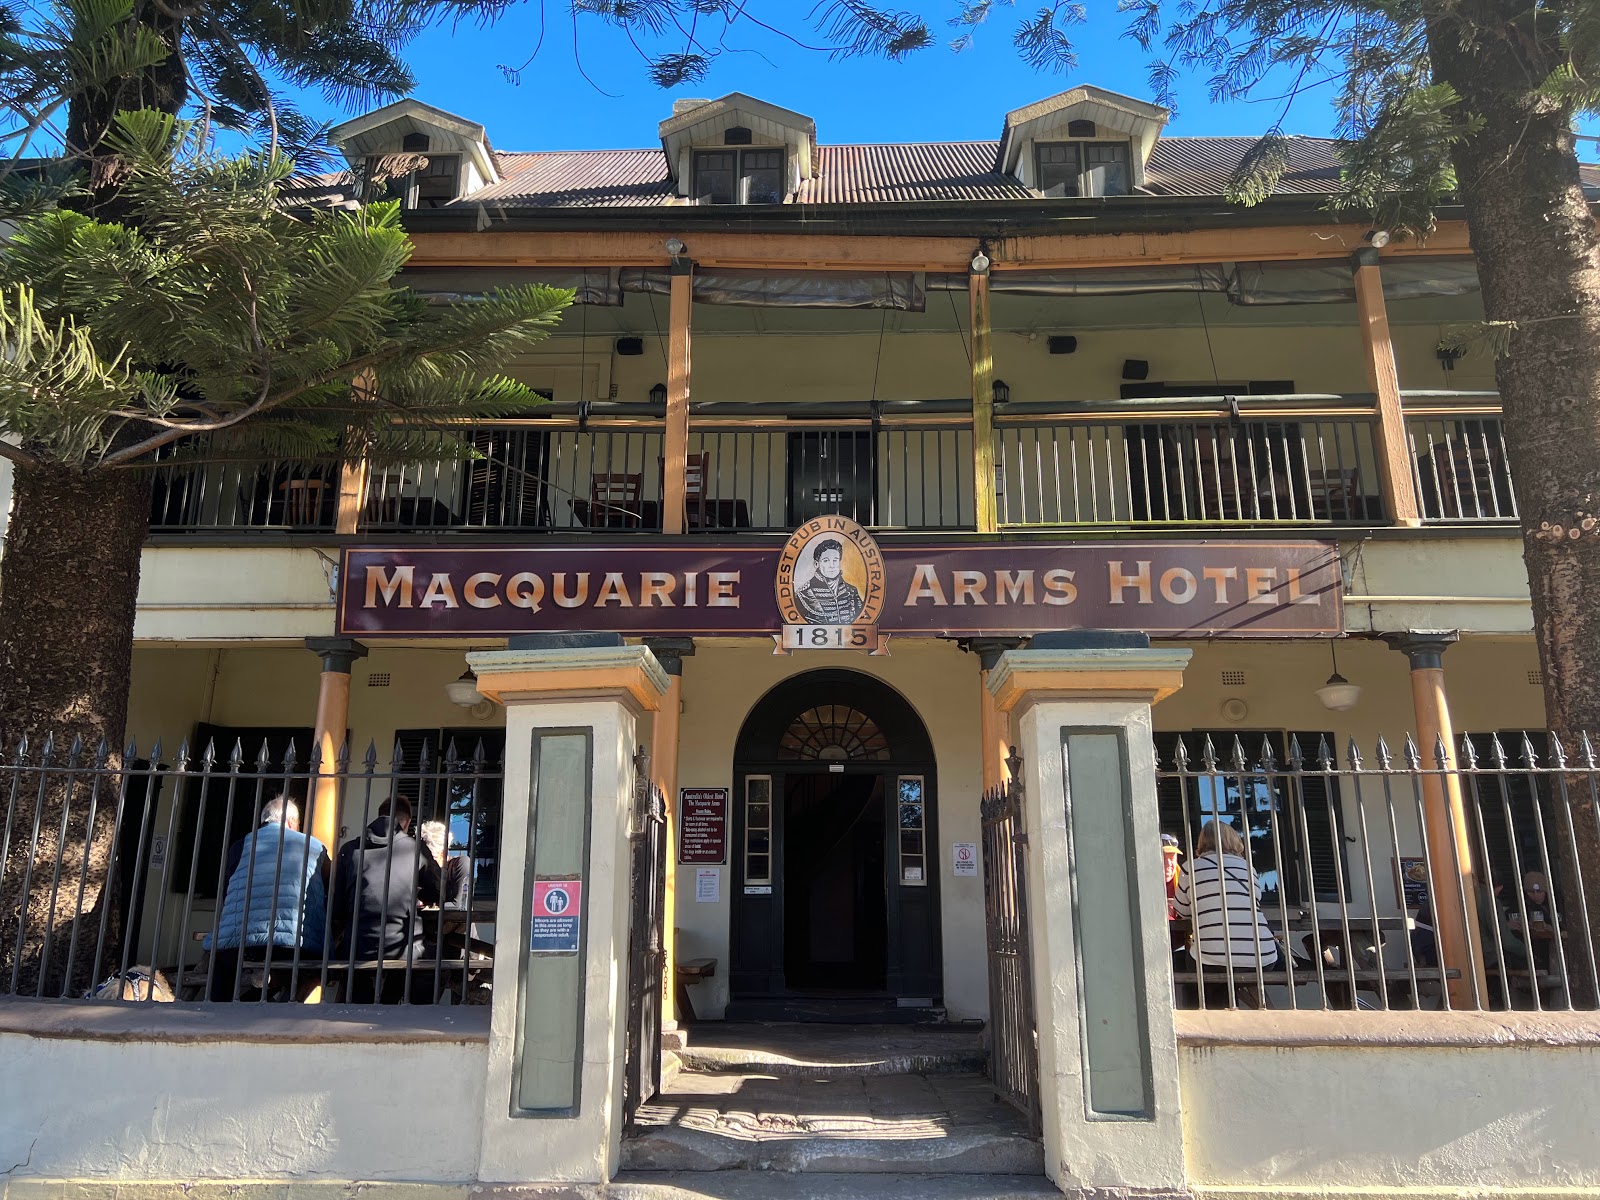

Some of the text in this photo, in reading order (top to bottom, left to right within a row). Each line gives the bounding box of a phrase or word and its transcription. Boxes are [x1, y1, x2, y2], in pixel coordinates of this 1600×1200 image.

[362, 560, 1321, 614] MACQUARIE ARMS HOTEL
[780, 518, 882, 622] OLDEST PUB IN AUSTRALIA
[795, 627, 868, 647] 1815
